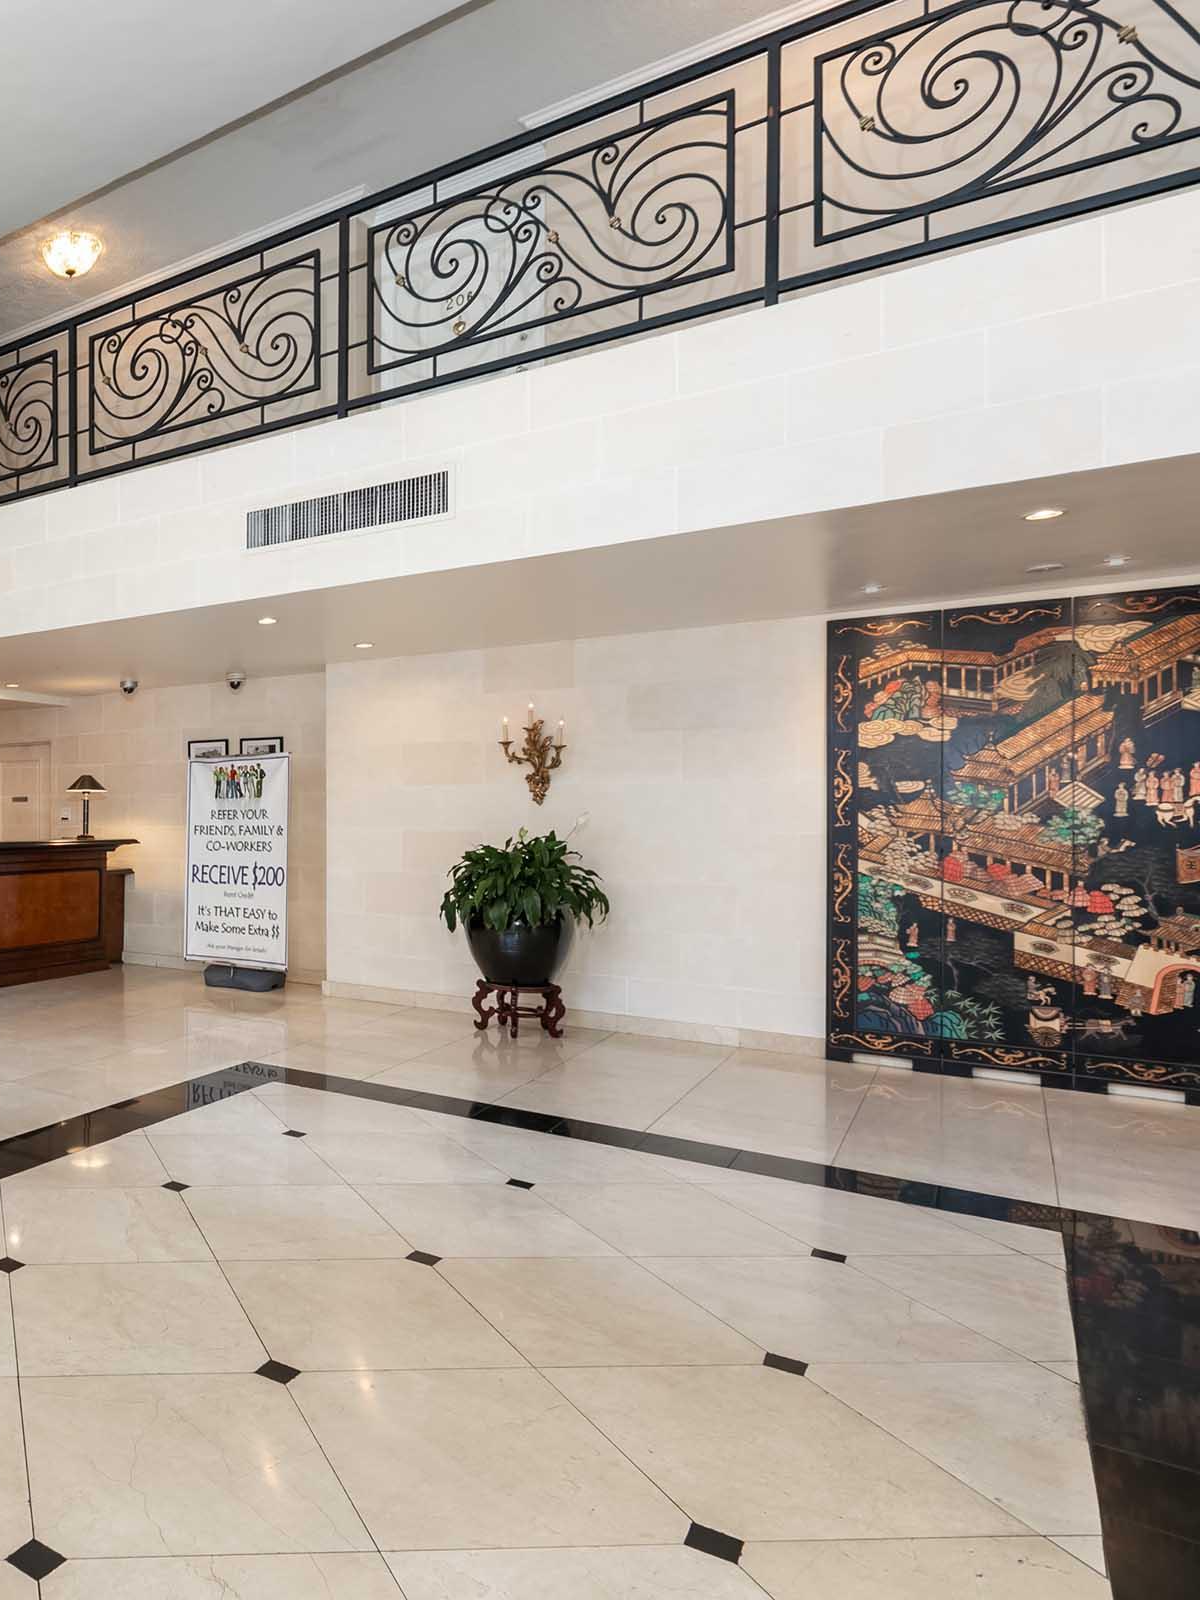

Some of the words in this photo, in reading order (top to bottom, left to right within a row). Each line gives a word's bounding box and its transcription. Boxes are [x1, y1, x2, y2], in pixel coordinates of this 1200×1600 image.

[210, 809, 238, 820] REFER
[240, 809, 268, 820] YOUR
[194, 825, 237, 837] FRIENDS,
[239, 825, 274, 836] FAMILY
[276, 826, 284, 836] &
[206, 841, 272, 852] CO-WORKERS
[192, 864, 248, 885] RECEIVE
[252, 861, 285, 890] $200
[198, 905, 211, 916] It's
[214, 906, 240, 917] THAT
[243, 907, 266, 919] EASY
[268, 909, 278, 920] to
[195, 921, 219, 933] Make
[221, 922, 246, 935] Some
[248, 924, 269, 937] Extra
[271, 925, 280, 939] $$
